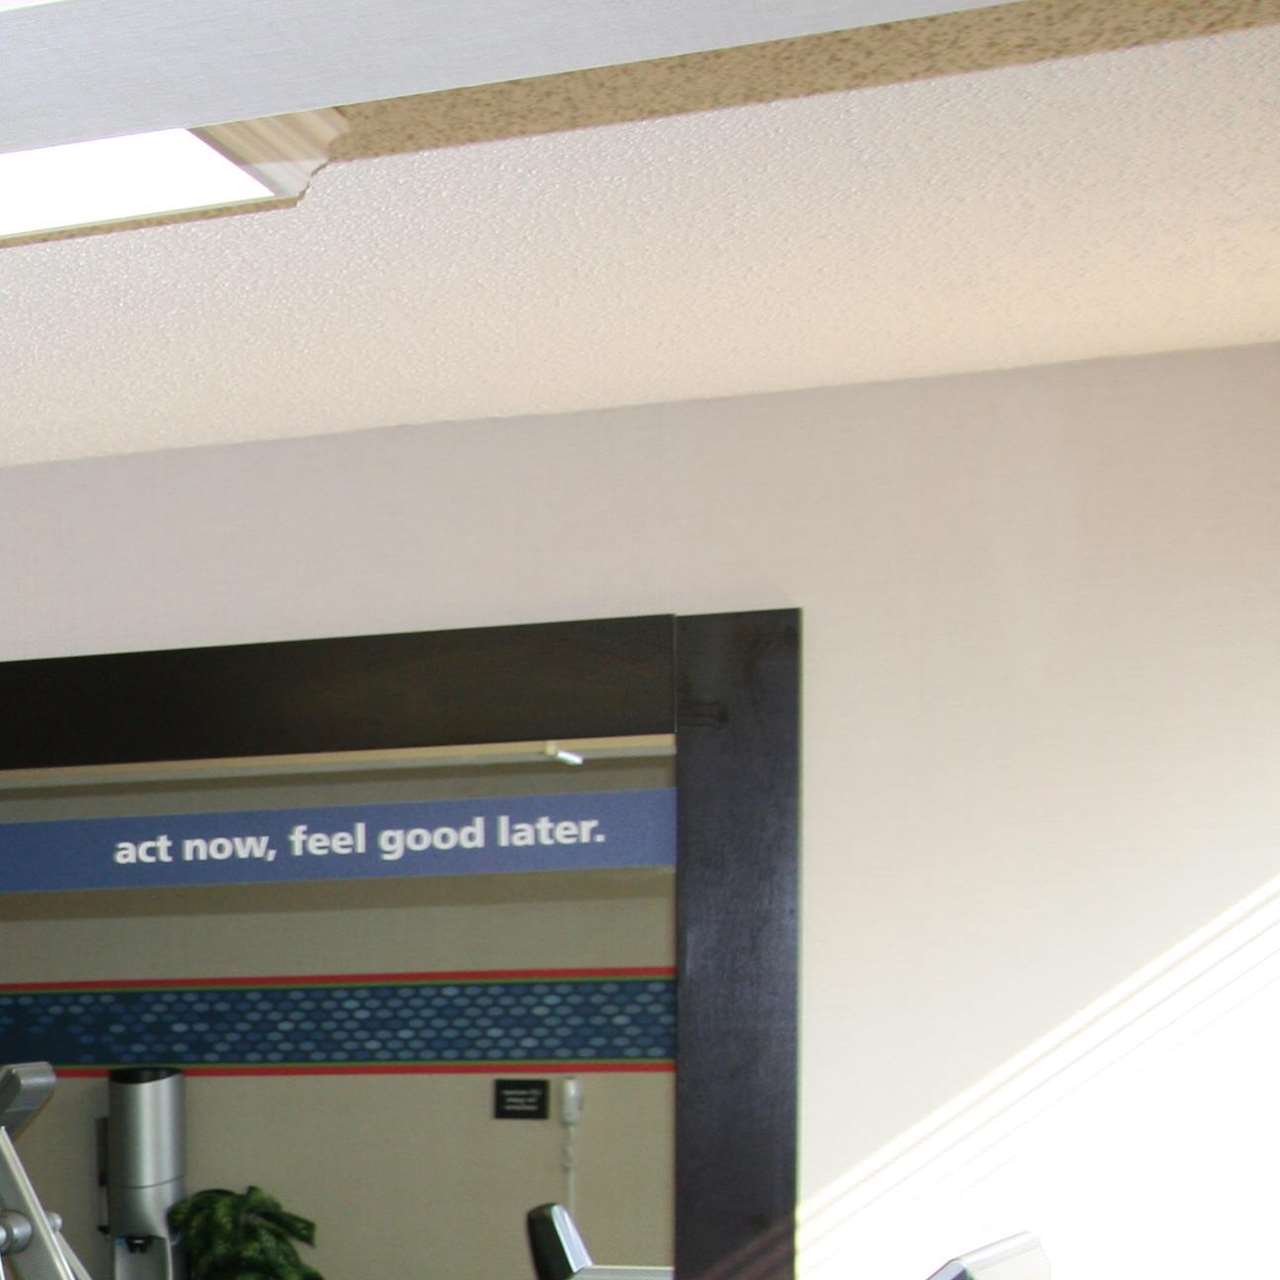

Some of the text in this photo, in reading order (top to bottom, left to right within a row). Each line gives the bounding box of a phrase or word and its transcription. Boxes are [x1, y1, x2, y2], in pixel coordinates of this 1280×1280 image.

[113, 813, 606, 864] act now, feel good later.
